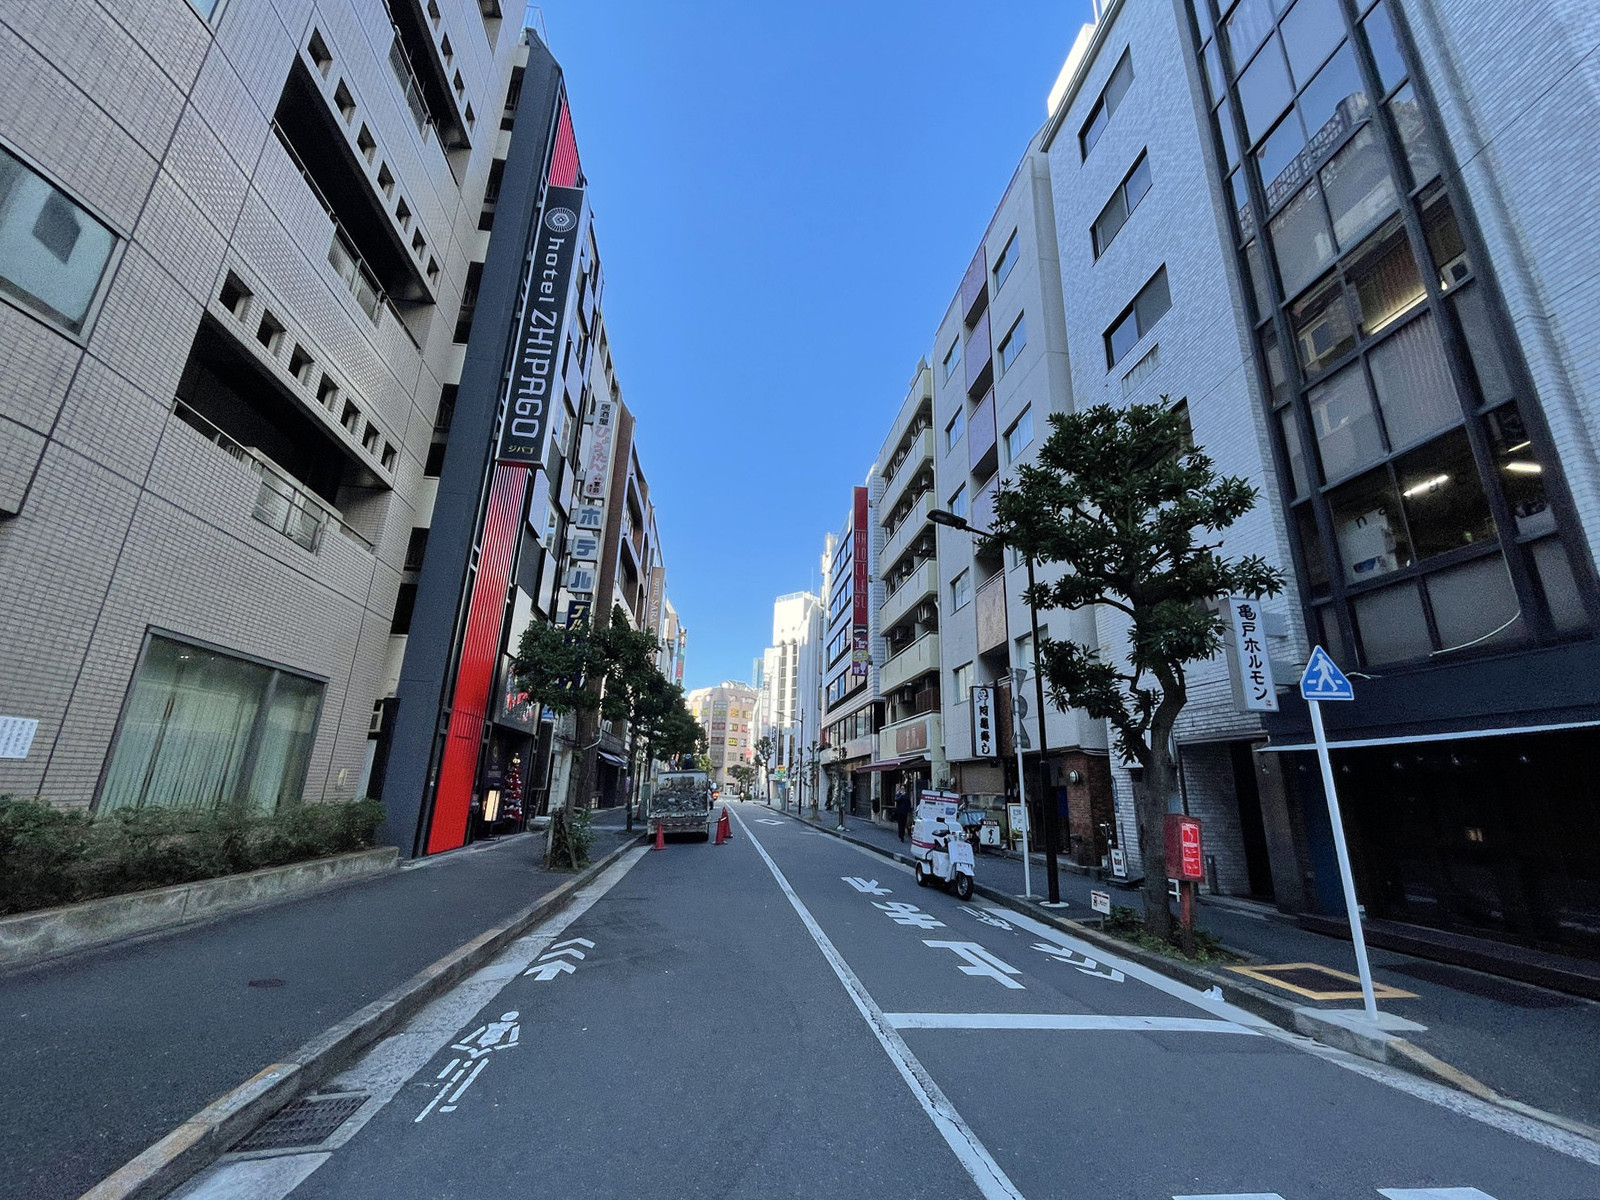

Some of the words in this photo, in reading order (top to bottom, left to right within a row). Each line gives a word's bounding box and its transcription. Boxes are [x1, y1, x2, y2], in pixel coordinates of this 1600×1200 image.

[539, 237, 565, 302] hotel
[511, 307, 558, 439] ZHIPAGO
[571, 508, 601, 589] ホテル
[650, 599, 660, 626] SARA
[1237, 604, 1267, 700] 亀戸ホルモン
